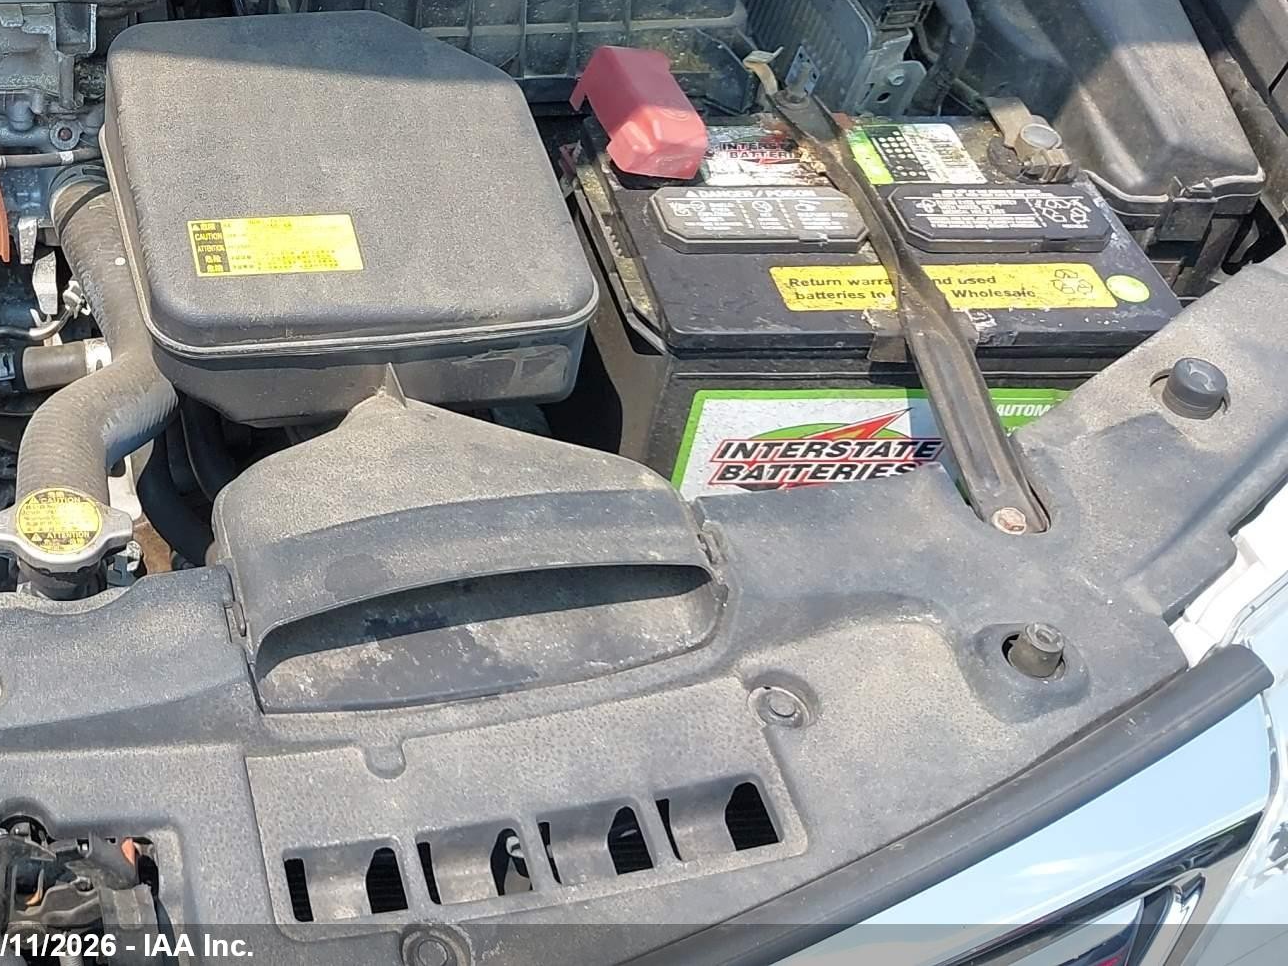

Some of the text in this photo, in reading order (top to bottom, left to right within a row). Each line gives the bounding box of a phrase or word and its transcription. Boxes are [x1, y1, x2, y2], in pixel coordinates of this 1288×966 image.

[195, 232, 223, 242] CAUTION
[789, 277, 842, 287] Return
[958, 275, 997, 285] used
[795, 290, 865, 300] batteries
[996, 404, 1053, 417] AUTOM
[717, 439, 939, 461] INTERSTATE
[716, 462, 916, 482] BATTERIES
[40, 496, 81, 504] CAUTION
[47, 531, 90, 539] ATTENTION
